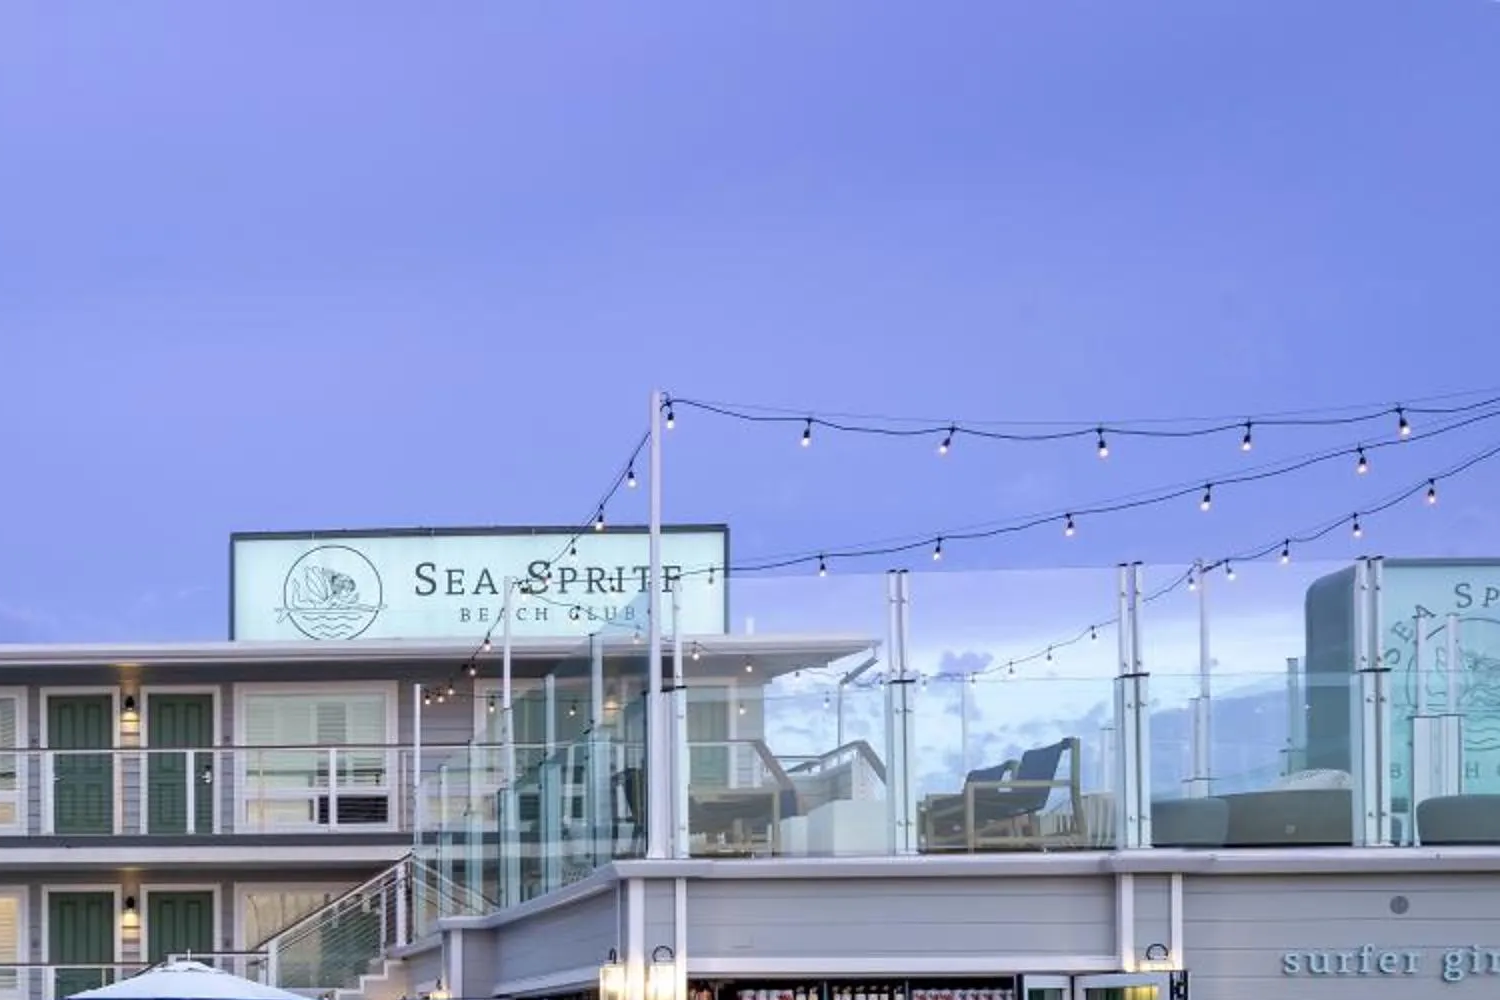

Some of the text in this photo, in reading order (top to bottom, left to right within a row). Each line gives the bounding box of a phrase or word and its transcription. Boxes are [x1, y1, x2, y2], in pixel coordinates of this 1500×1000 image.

[414, 561, 499, 596] SEA
[459, 606, 635, 622] BECH CLUB
[1283, 943, 1420, 974] surfer
